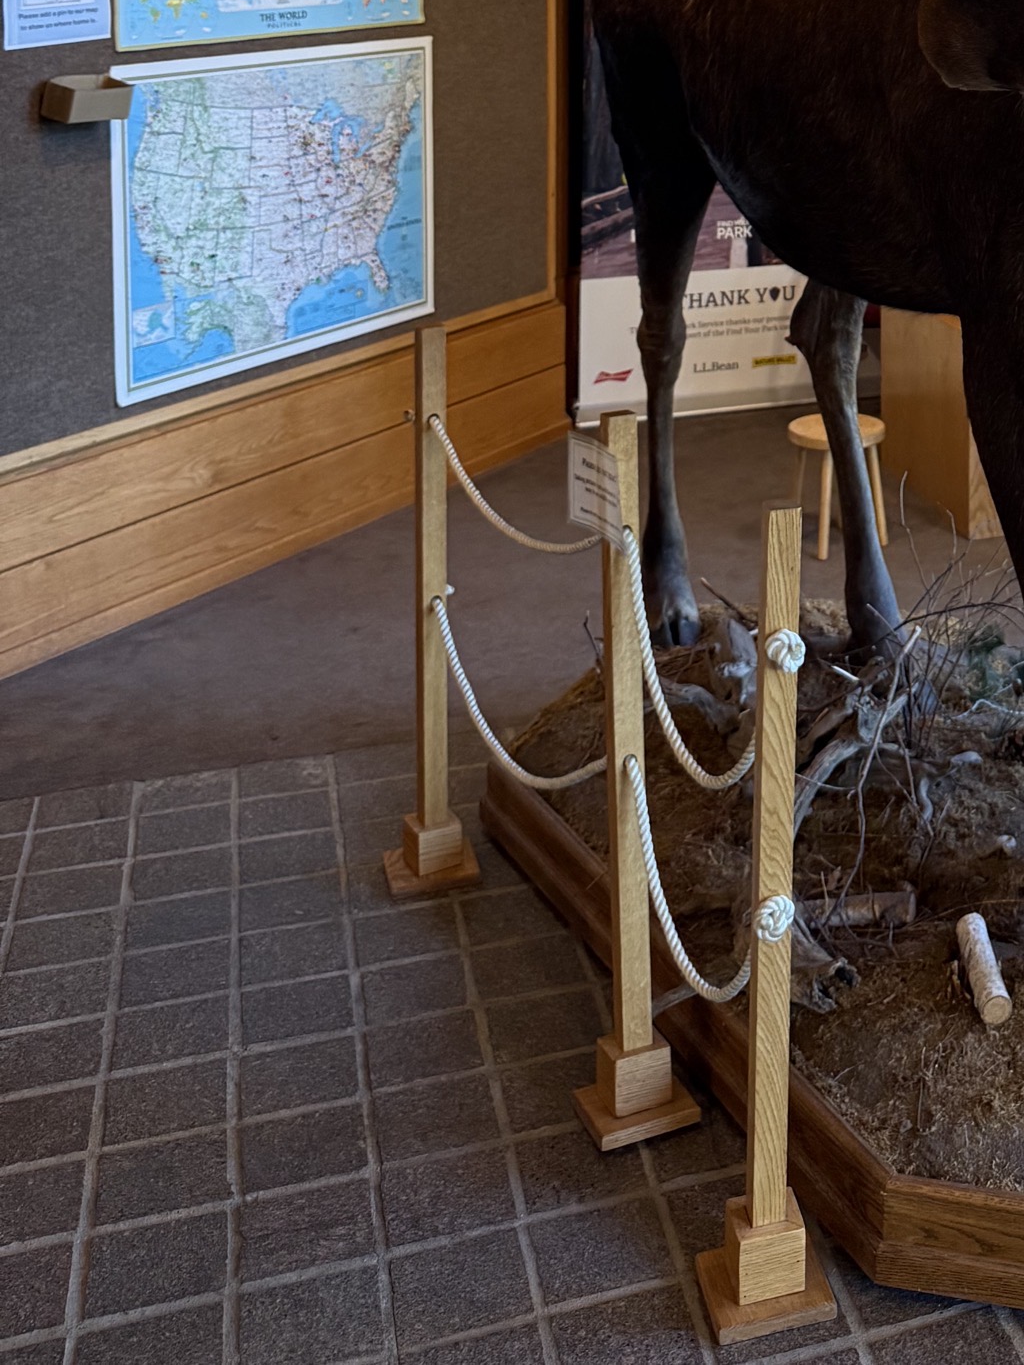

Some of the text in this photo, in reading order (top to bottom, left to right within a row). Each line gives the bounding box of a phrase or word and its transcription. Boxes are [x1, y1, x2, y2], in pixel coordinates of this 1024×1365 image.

[278, 10, 308, 20] WORLD
[716, 225, 753, 240] PARK
[693, 361, 740, 374] L.L.Bean
